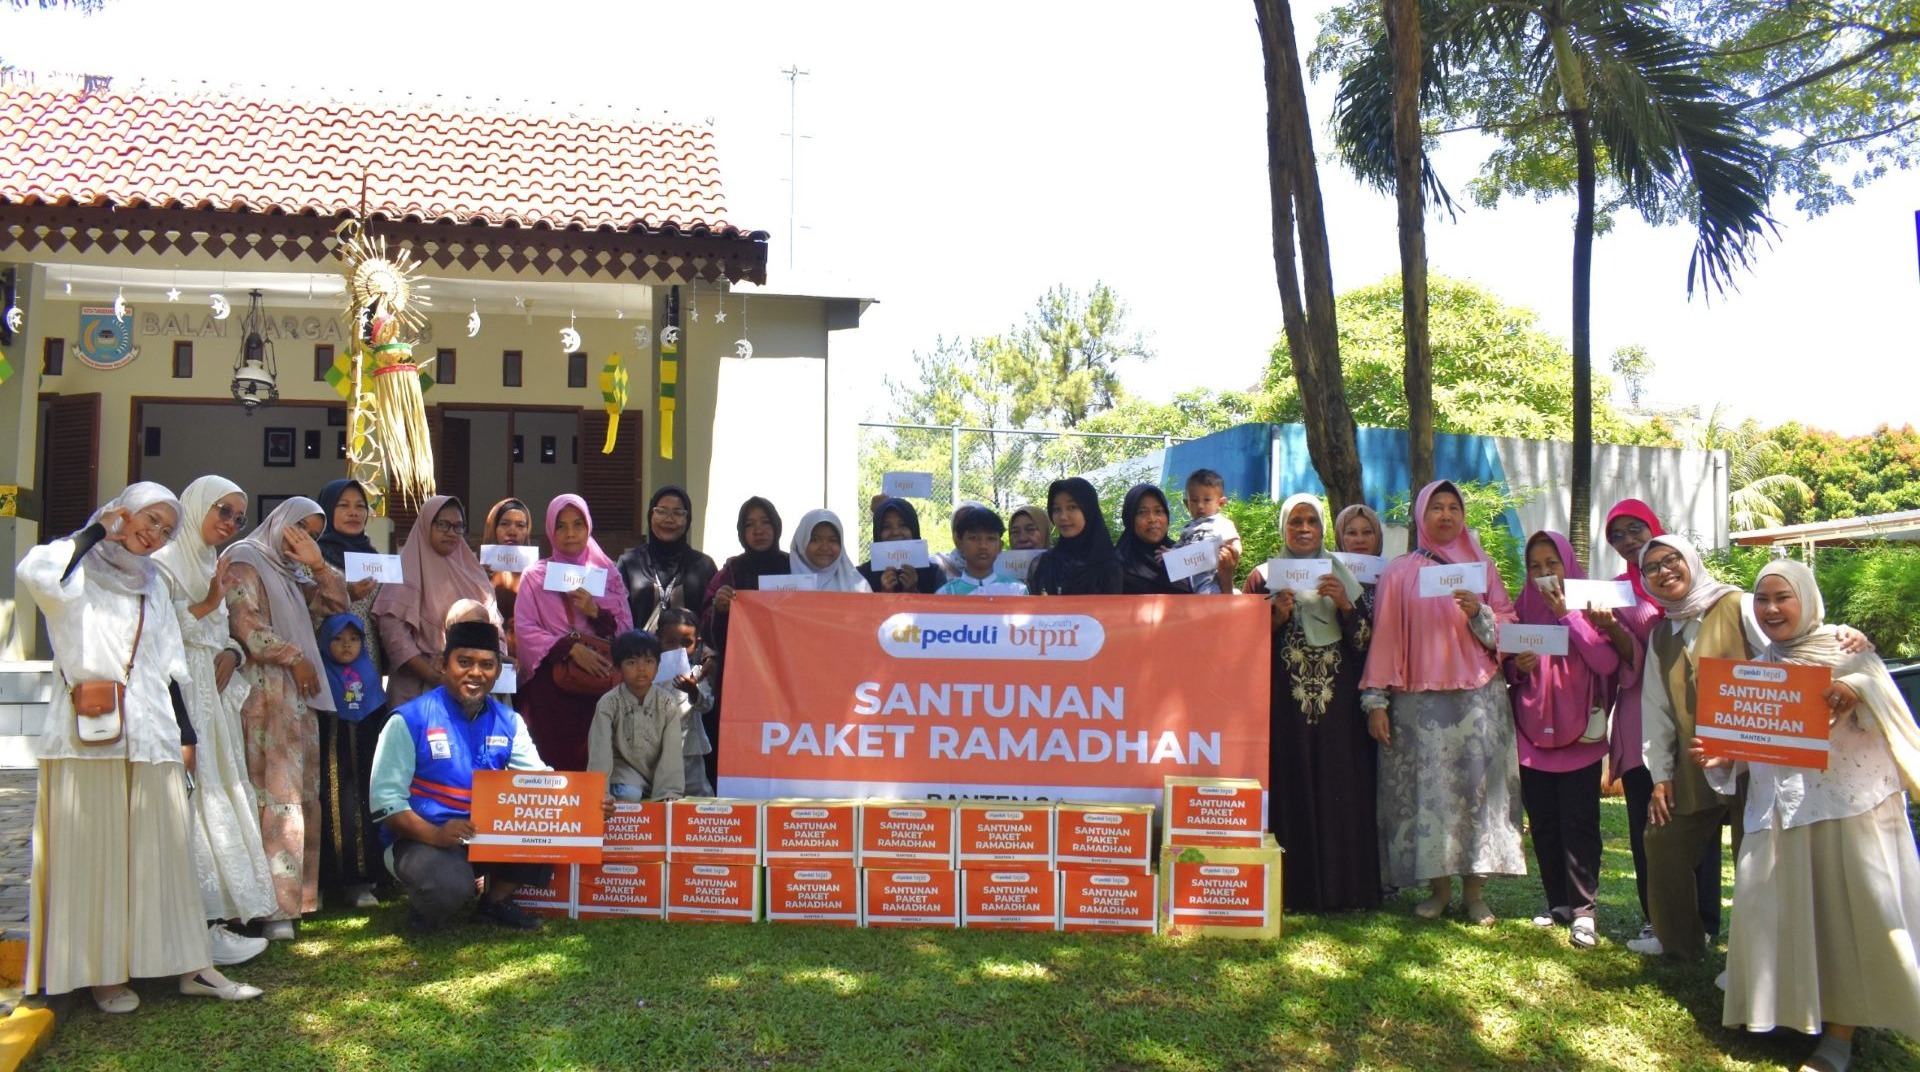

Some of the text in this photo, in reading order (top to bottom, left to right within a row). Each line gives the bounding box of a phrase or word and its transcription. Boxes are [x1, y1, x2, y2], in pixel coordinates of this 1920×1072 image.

[142, 312, 227, 338] BALAI
[1286, 569, 1310, 582] btpn
[1440, 575, 1463, 587] btpn
[1009, 623, 1079, 655] btpn
[1719, 684, 1802, 703] SANTUNAN
[854, 682, 1124, 720] SANTUNAN
[1733, 700, 1783, 716] PAKET
[1714, 712, 1804, 733] RAMADHAN
[1740, 733, 1767, 742] BANTEN
[761, 722, 1221, 765] PAKET RAMADHAN
[497, 793, 580, 806] SANTUNAN
[1189, 799, 1246, 808] SANTUNAN
[514, 807, 563, 819] PAKET
[1200, 808, 1234, 816] PAKET
[606, 816, 651, 824] ANTUNAN
[687, 817, 741, 826] SANTUNAN
[1187, 816, 1247, 825] RAMADHAN
[493, 819, 582, 832] RAMADHAN
[608, 824, 640, 832] PAKET
[698, 826, 730, 834] PAKET
[783, 822, 837, 830] SANTUNAN
[880, 821, 934, 831] SANTUNAN
[977, 824, 1032, 832] SANTUNAN
[891, 830, 923, 839] PAKET
[1074, 826, 1130, 836] SANTUNAN
[603, 833, 652, 841] AMADHAN
[685, 834, 742, 843] RAMADHAN
[989, 832, 1021, 841] PAKET
[1086, 835, 1119, 844] PAKET
[781, 839, 839, 847] RAMADHAN
[877, 838, 936, 848] RAMADHAN
[975, 841, 1034, 849] RAMADHAN
[1072, 843, 1132, 853] RAMADHAN
[594, 877, 646, 886] SANTUNAN
[684, 878, 737, 888] SANTUNAN
[1191, 879, 1247, 888] SANTUNAN
[604, 886, 635, 894] PAKET
[695, 887, 727, 895] PAKET
[786, 884, 840, 892] SANTUNAN
[884, 886, 938, 894] SANTUNAN
[983, 886, 1038, 894] SANTUNAN
[1081, 888, 1137, 897] SANTUNAN
[1203, 887, 1236, 896] PAKET
[592, 893, 648, 903] RAMADHAN
[682, 894, 739, 904] RAMADHAN
[798, 892, 829, 900] PAKET
[895, 895, 928, 903] PAKET
[1189, 895, 1249, 905] RAMADHAN
[785, 900, 842, 908] RAMADHAN
[1093, 897, 1126, 906] PAKET
[882, 903, 940, 912] RAMADHAN
[981, 903, 1040, 911] RAMADHAN
[1079, 905, 1139, 915] RAMADHAN
